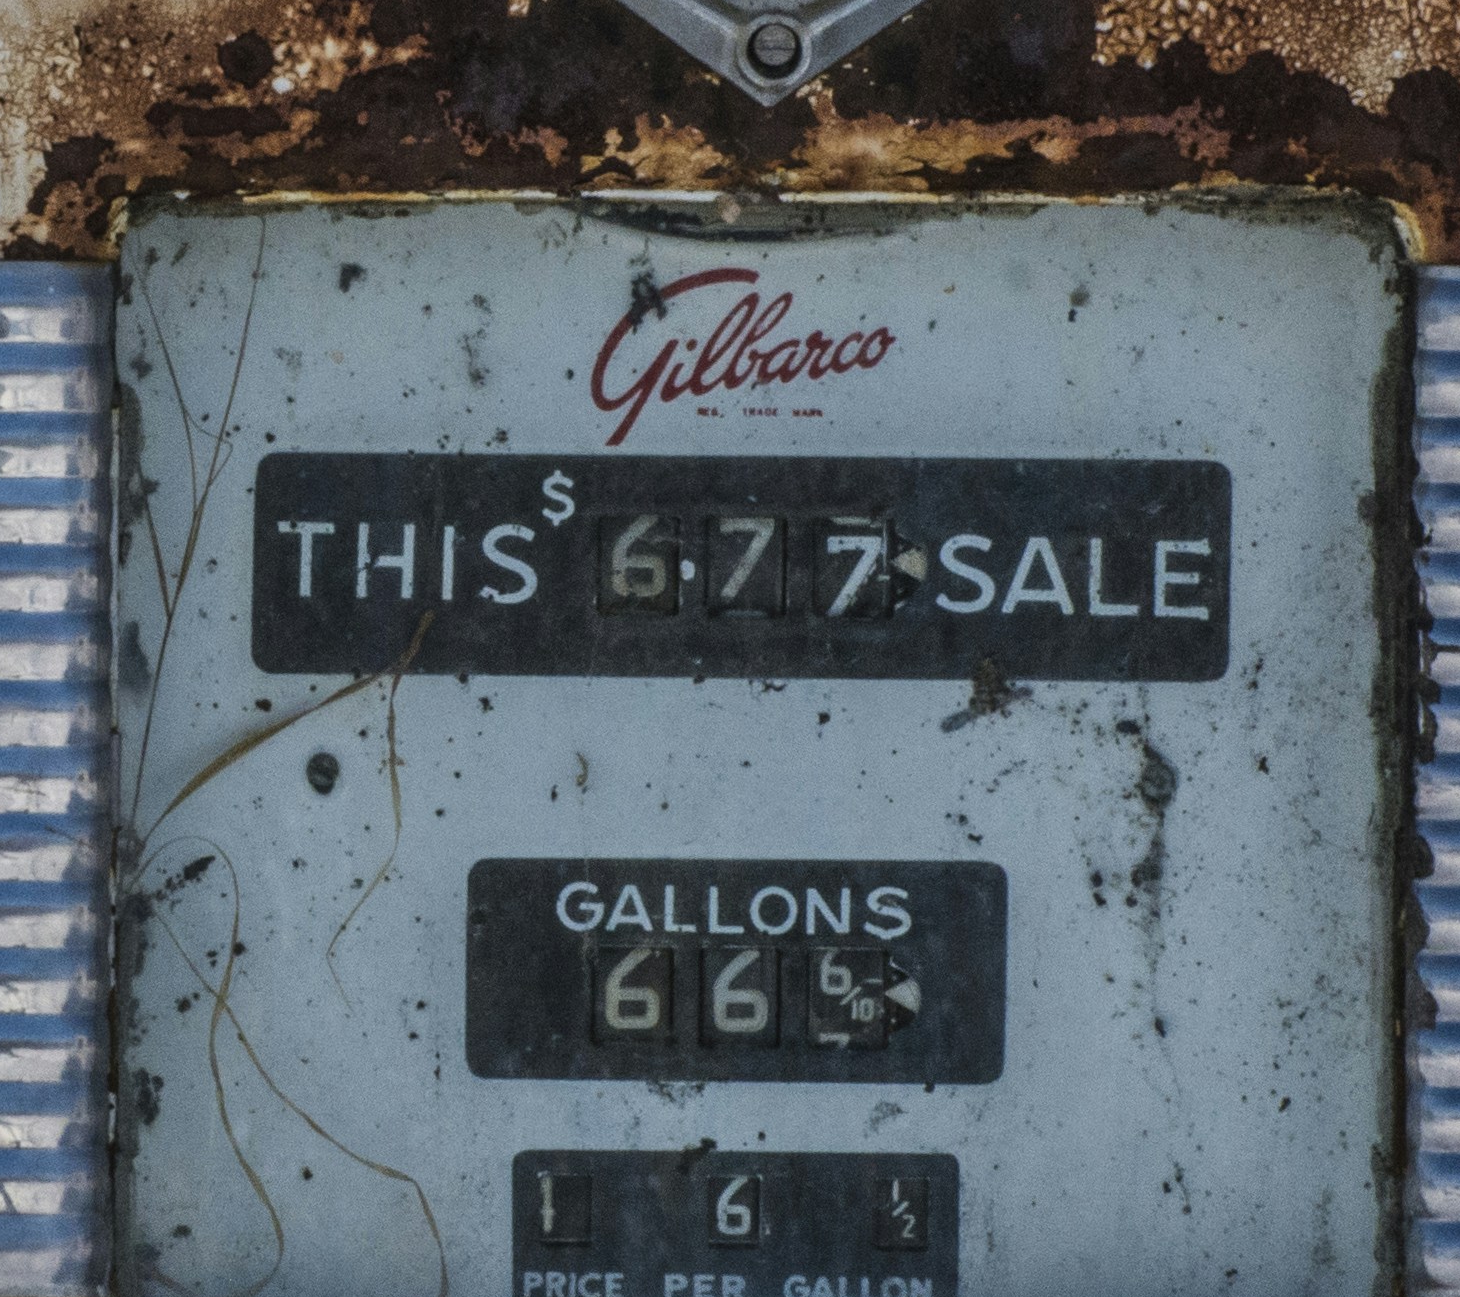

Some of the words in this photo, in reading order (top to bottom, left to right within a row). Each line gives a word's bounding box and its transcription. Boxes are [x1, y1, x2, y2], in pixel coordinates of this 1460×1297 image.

[589, 266, 897, 448] Gilbarco
[277, 521, 538, 606] THIS
[540, 469, 577, 526] $
[934, 534, 1211, 622] SALE
[556, 881, 913, 940] GALLONS
[715, 1176, 753, 1237] 6
